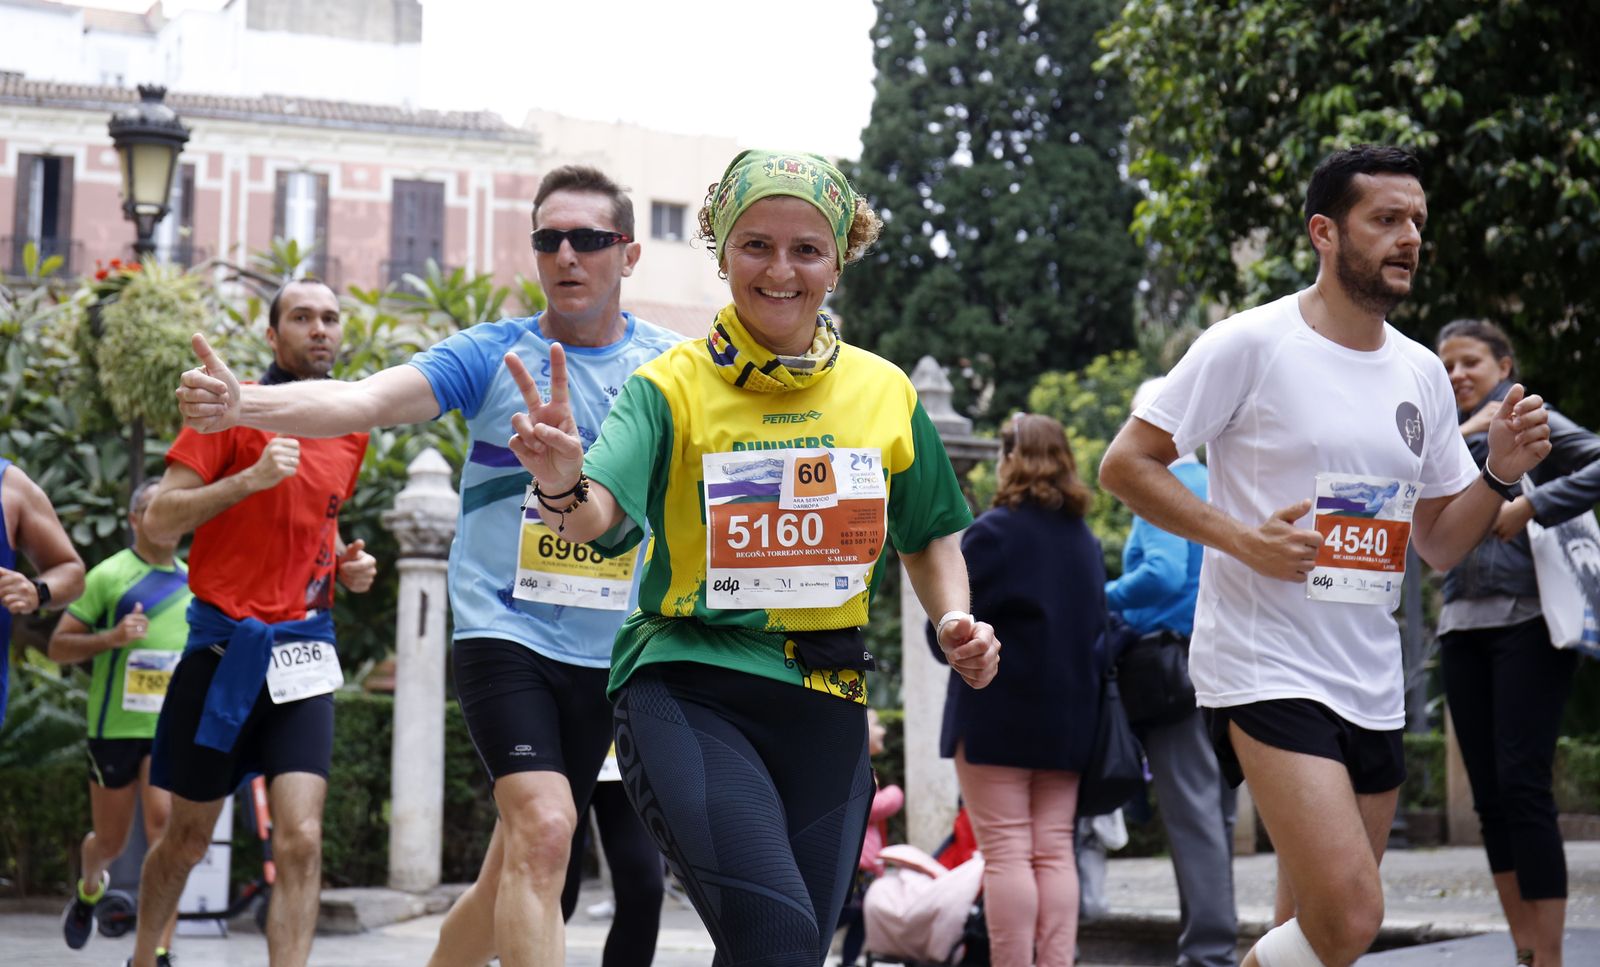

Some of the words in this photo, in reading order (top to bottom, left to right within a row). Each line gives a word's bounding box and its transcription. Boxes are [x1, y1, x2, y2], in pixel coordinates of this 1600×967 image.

[798, 462, 827, 484] 60
[727, 513, 823, 549] 5160
[1324, 525, 1388, 556] 4540
[805, 548, 840, 556] RONCERO
[520, 577, 538, 590] edp
[712, 576, 740, 595] edp
[1312, 574, 1333, 589] edp
